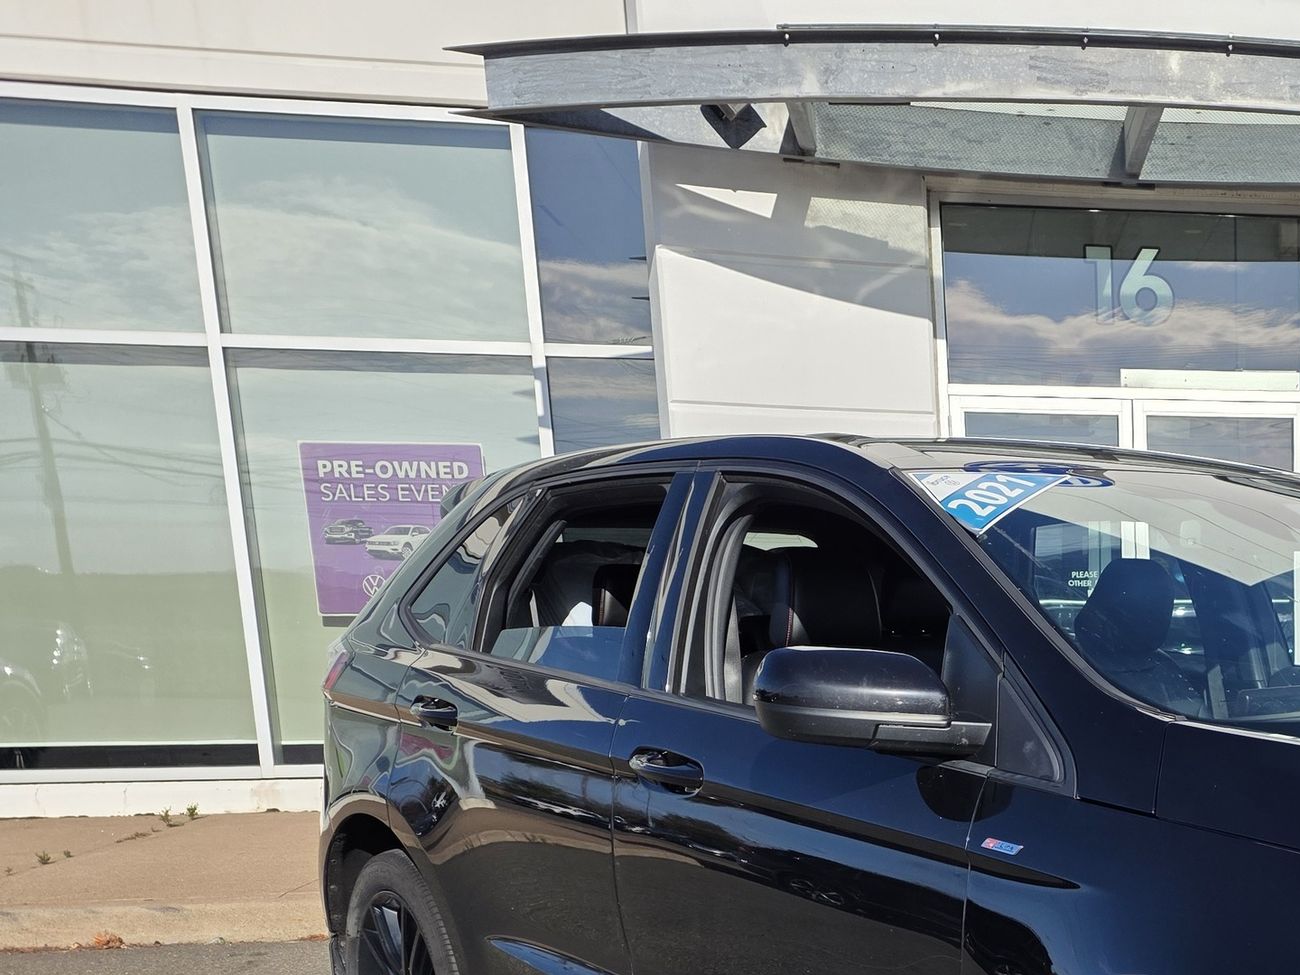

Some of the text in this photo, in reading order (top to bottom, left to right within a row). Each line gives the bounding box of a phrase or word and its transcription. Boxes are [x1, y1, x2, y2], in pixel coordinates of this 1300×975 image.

[1084, 244, 1175, 327] 16
[316, 460, 469, 479] PRE-OWNED
[320, 483, 390, 502] SALES
[947, 474, 1037, 517] 2021
